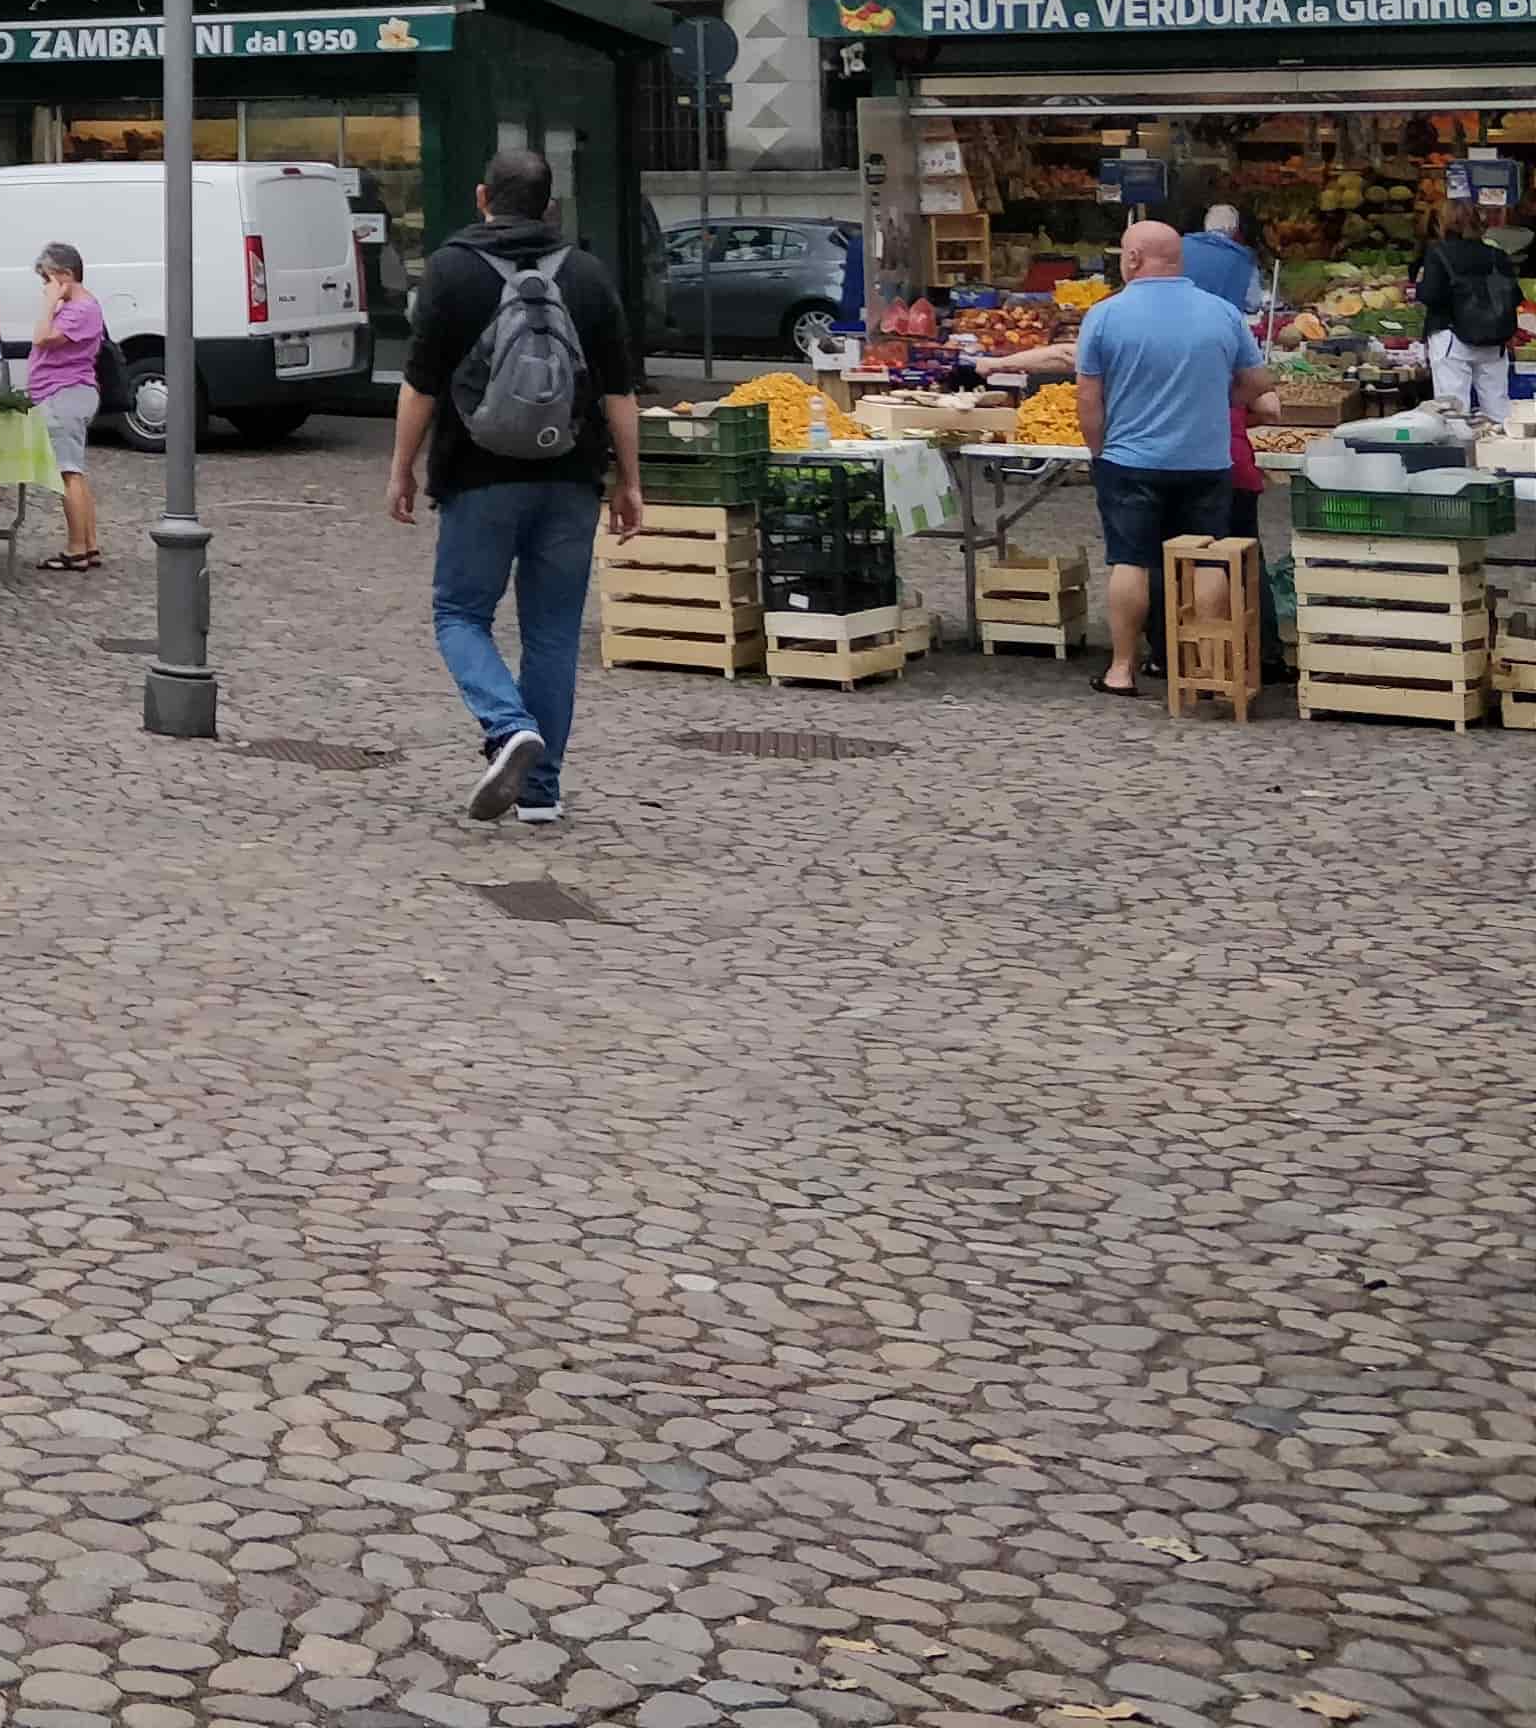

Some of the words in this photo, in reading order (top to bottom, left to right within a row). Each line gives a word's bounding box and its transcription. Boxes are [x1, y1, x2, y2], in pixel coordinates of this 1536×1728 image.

[1074, 11, 1089, 28] e
[1297, 0, 1329, 23] da
[1475, 0, 1493, 18] e
[245, 29, 287, 53] dal
[293, 28, 358, 50] 1950
